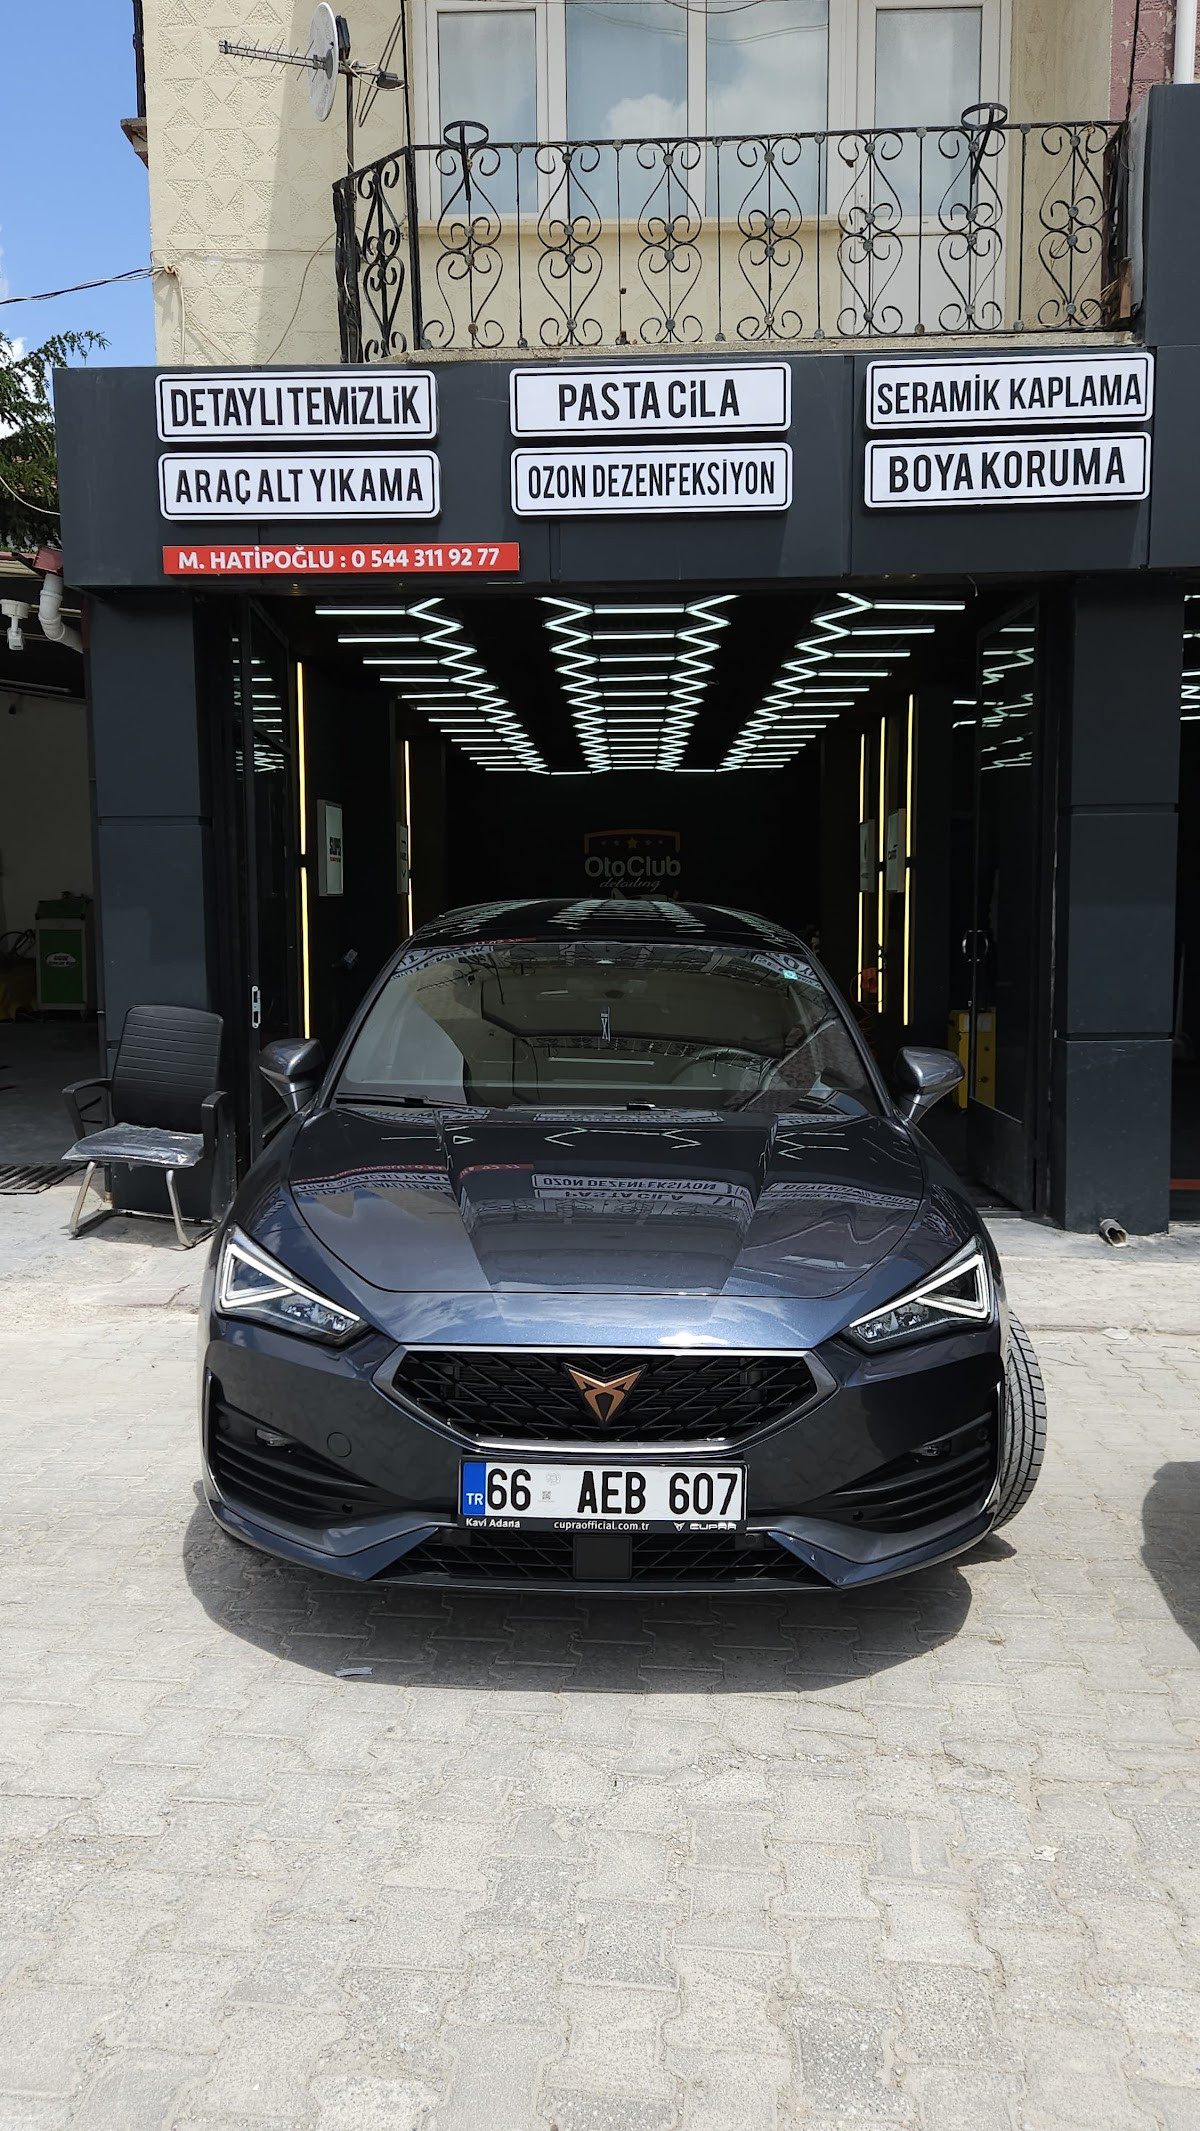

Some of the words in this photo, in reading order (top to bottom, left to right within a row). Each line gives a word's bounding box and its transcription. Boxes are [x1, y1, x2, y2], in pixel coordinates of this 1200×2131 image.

[558, 381, 661, 422] PASTA
[877, 373, 1000, 415] SERAMİK
[1009, 373, 1142, 410] KAPLAMA
[528, 464, 586, 499] OZON
[592, 459, 775, 498] DEZENFEKSİYON
[889, 453, 974, 494] BOYA
[981, 446, 1126, 490] KORUMA
[175, 469, 251, 505] ARAÇ
[257, 468, 303, 503] ALT
[309, 467, 424, 502] YIKAMA
[178, 551, 205, 569] M.
[210, 545, 334, 569] HATİPOĞLU
[351, 549, 366, 568] 0
[371, 549, 410, 568] 544
[414, 548, 443, 567] 311
[448, 548, 473, 567] 92
[477, 547, 500, 566] 77
[584, 856, 681, 877] OtoClub
[600, 877, 663, 892] detailing
[466, 1492, 484, 1506] TR
[486, 1468, 532, 1512] 66
[576, 1470, 647, 1515] AEB
[668, 1472, 738, 1516] 607
[488, 1518, 521, 1529] Adana
[553, 1519, 650, 1531] cupraofficial.com.tr
[689, 1521, 737, 1531] CUPRA
